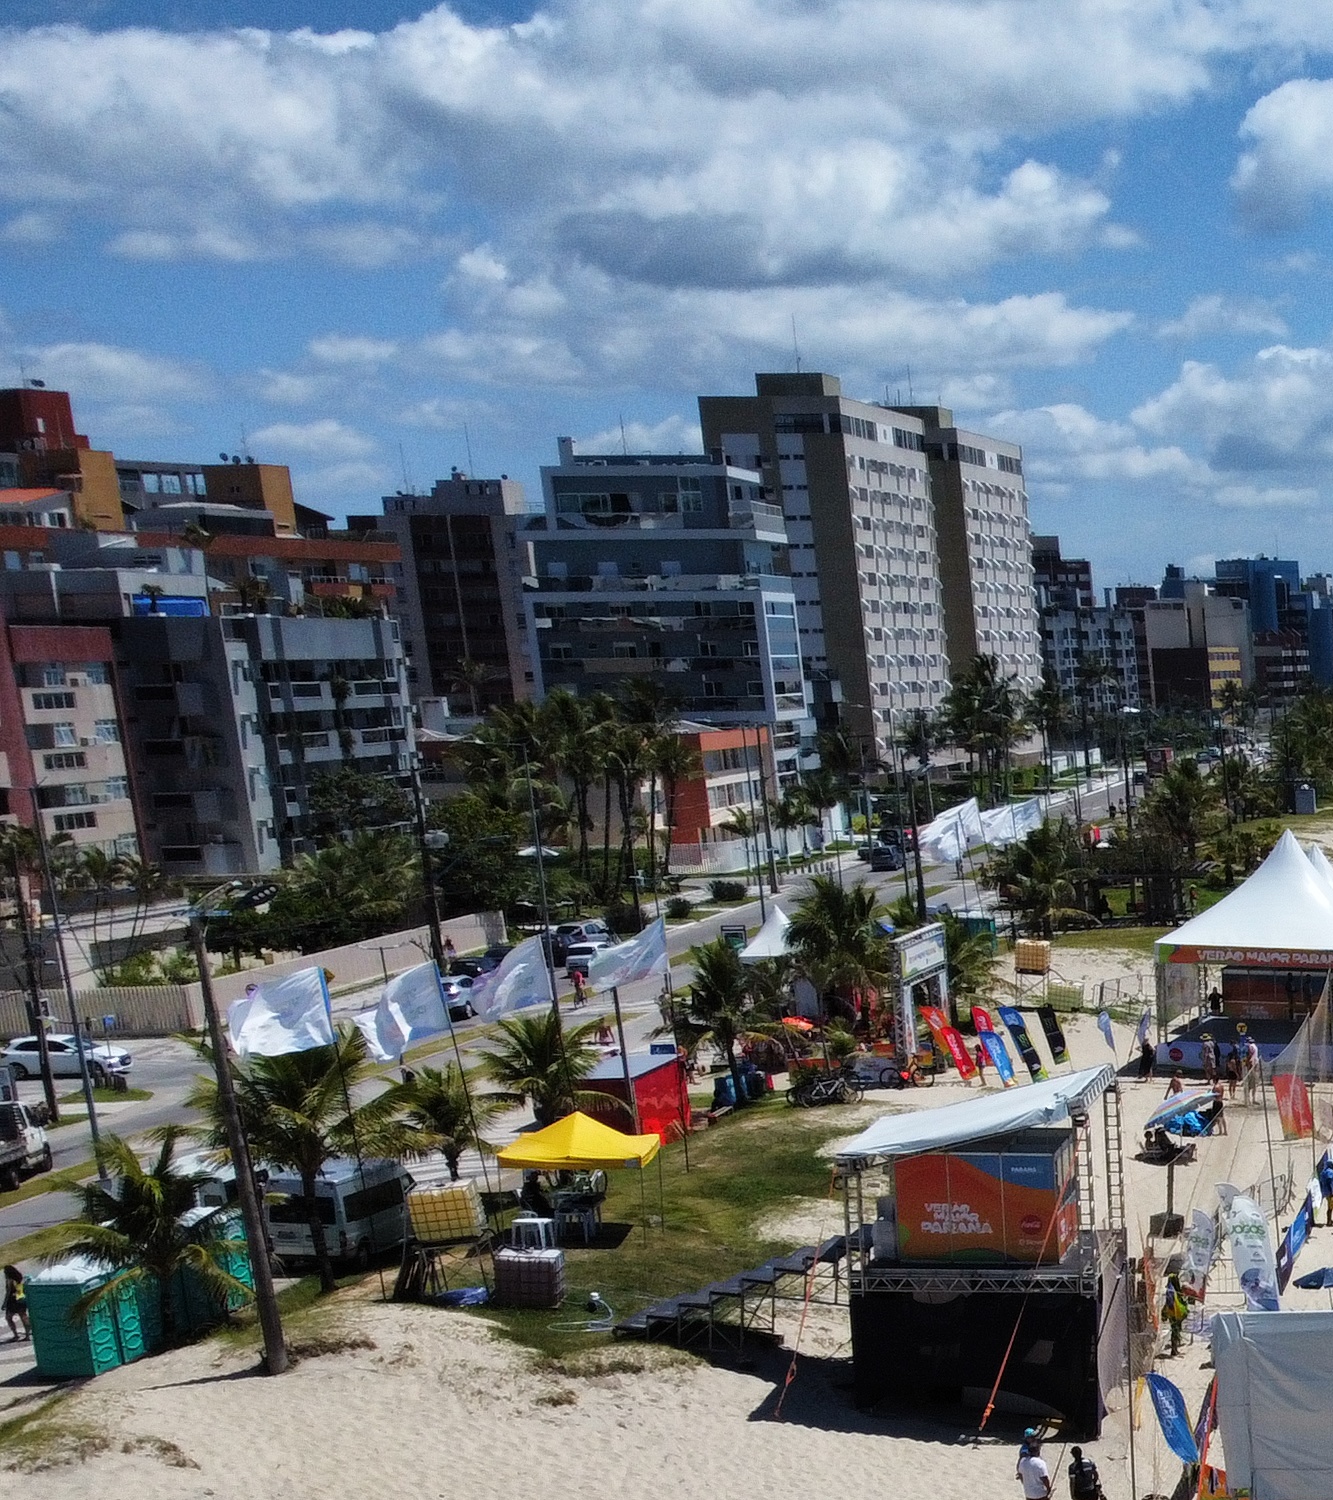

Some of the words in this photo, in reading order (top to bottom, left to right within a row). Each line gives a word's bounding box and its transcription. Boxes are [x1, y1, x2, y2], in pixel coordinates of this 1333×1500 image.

[1197, 948, 1244, 962] VERÃO
[1246, 951, 1291, 963] MAIOR
[1231, 1224, 1265, 1235] JOGOS
